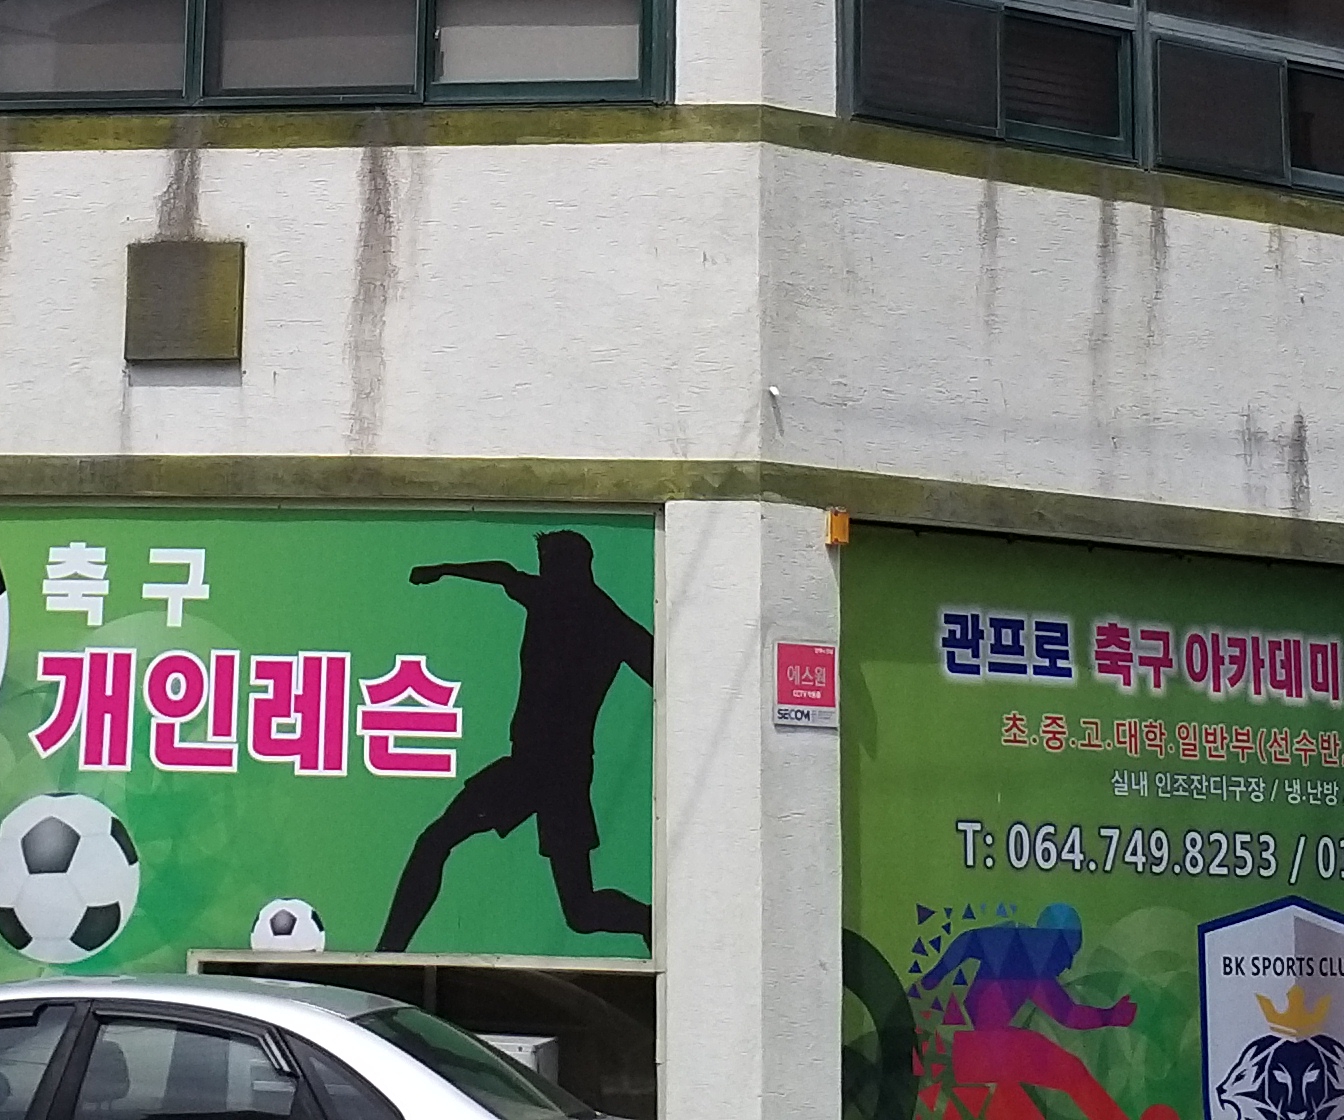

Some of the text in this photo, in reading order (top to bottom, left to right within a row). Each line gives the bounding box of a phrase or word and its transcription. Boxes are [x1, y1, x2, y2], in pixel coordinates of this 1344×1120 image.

[940, 611, 1075, 681] 관프로
[1092, 620, 1176, 691] 축구
[1183, 630, 1342, 703] 아카데미
[787, 666, 826, 687] 에스원
[28, 647, 463, 777] 개인레슨
[777, 709, 810, 721] SECOM
[1111, 770, 1149, 797] 실내
[1155, 772, 1266, 803] 인조잔디구장
[1284, 778, 1339, 806] 냉.난방
[957, 821, 995, 869] T:
[1007, 823, 1278, 878] 064.749.8253
[1289, 835, 1306, 884] /
[1222, 956, 1246, 976] BK
[1251, 956, 1314, 977] SPORTS
